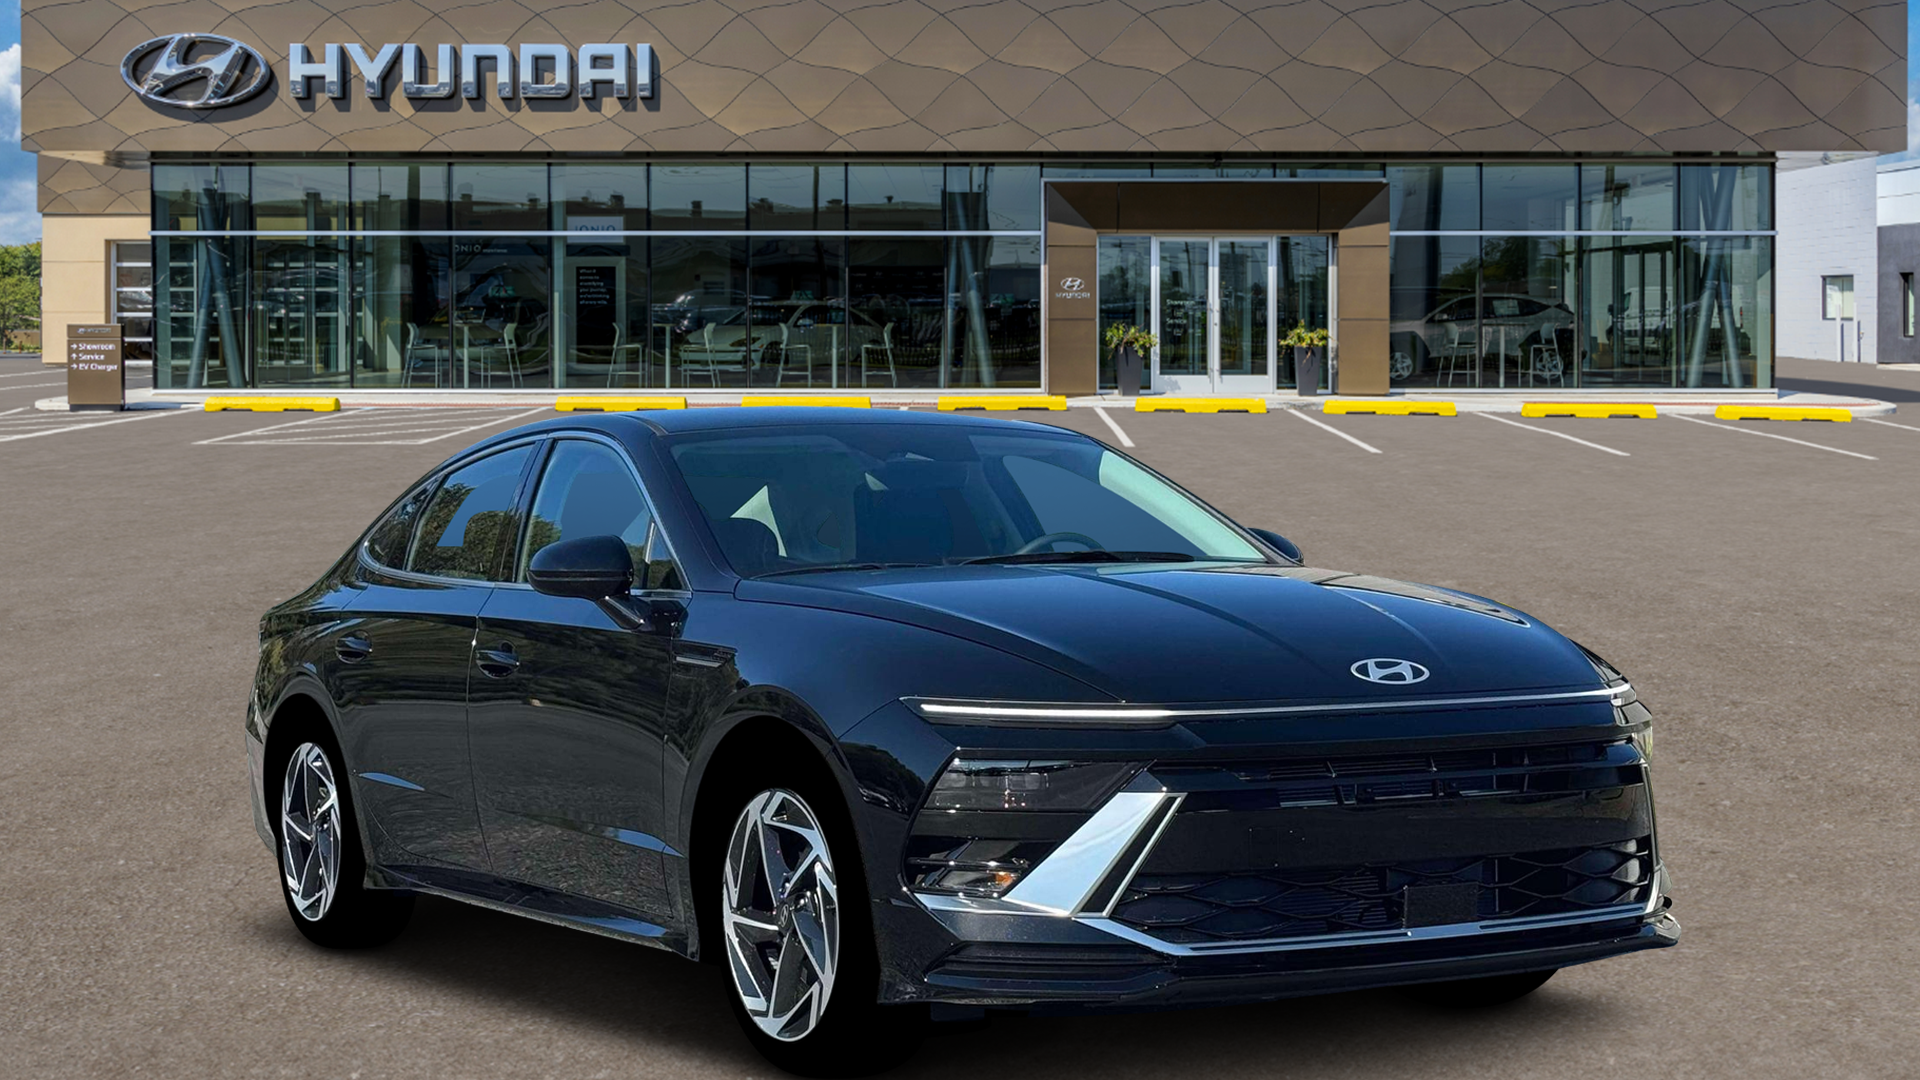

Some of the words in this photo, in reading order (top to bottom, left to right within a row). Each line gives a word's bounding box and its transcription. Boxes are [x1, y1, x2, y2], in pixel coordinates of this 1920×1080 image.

[289, 43, 655, 99] HYUNDAI
[78, 343, 116, 351] Showroom
[78, 352, 105, 360] Service
[90, 363, 118, 372] Charger
